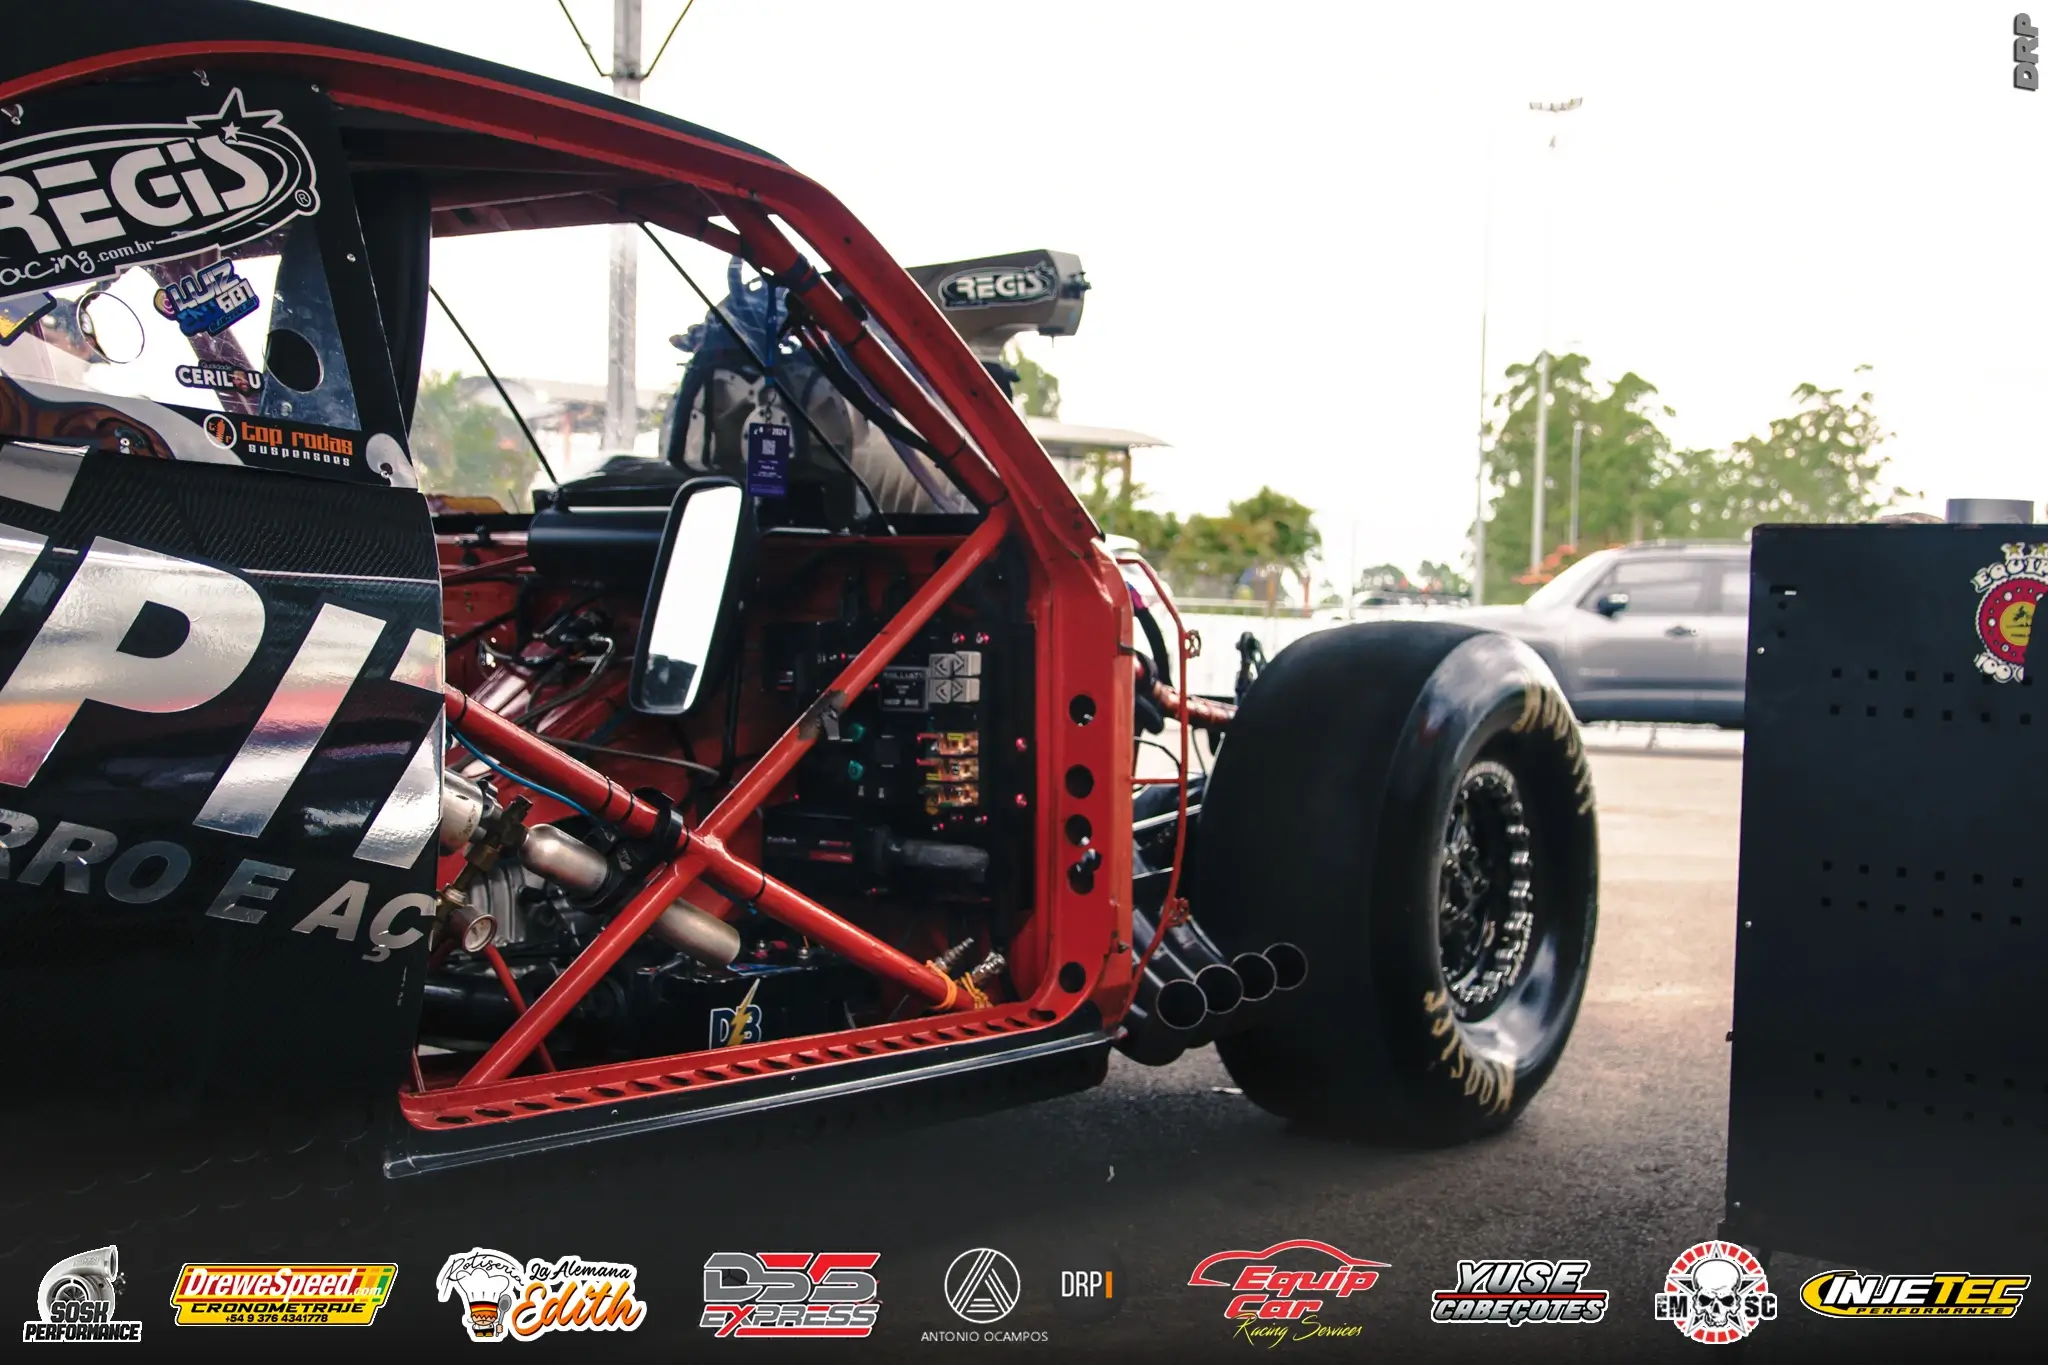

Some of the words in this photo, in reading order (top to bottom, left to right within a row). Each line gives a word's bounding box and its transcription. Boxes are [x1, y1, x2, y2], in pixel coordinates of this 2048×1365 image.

[241, 421, 283, 447] top
[291, 431, 353, 456] rodas
[205, 858, 296, 925] E
